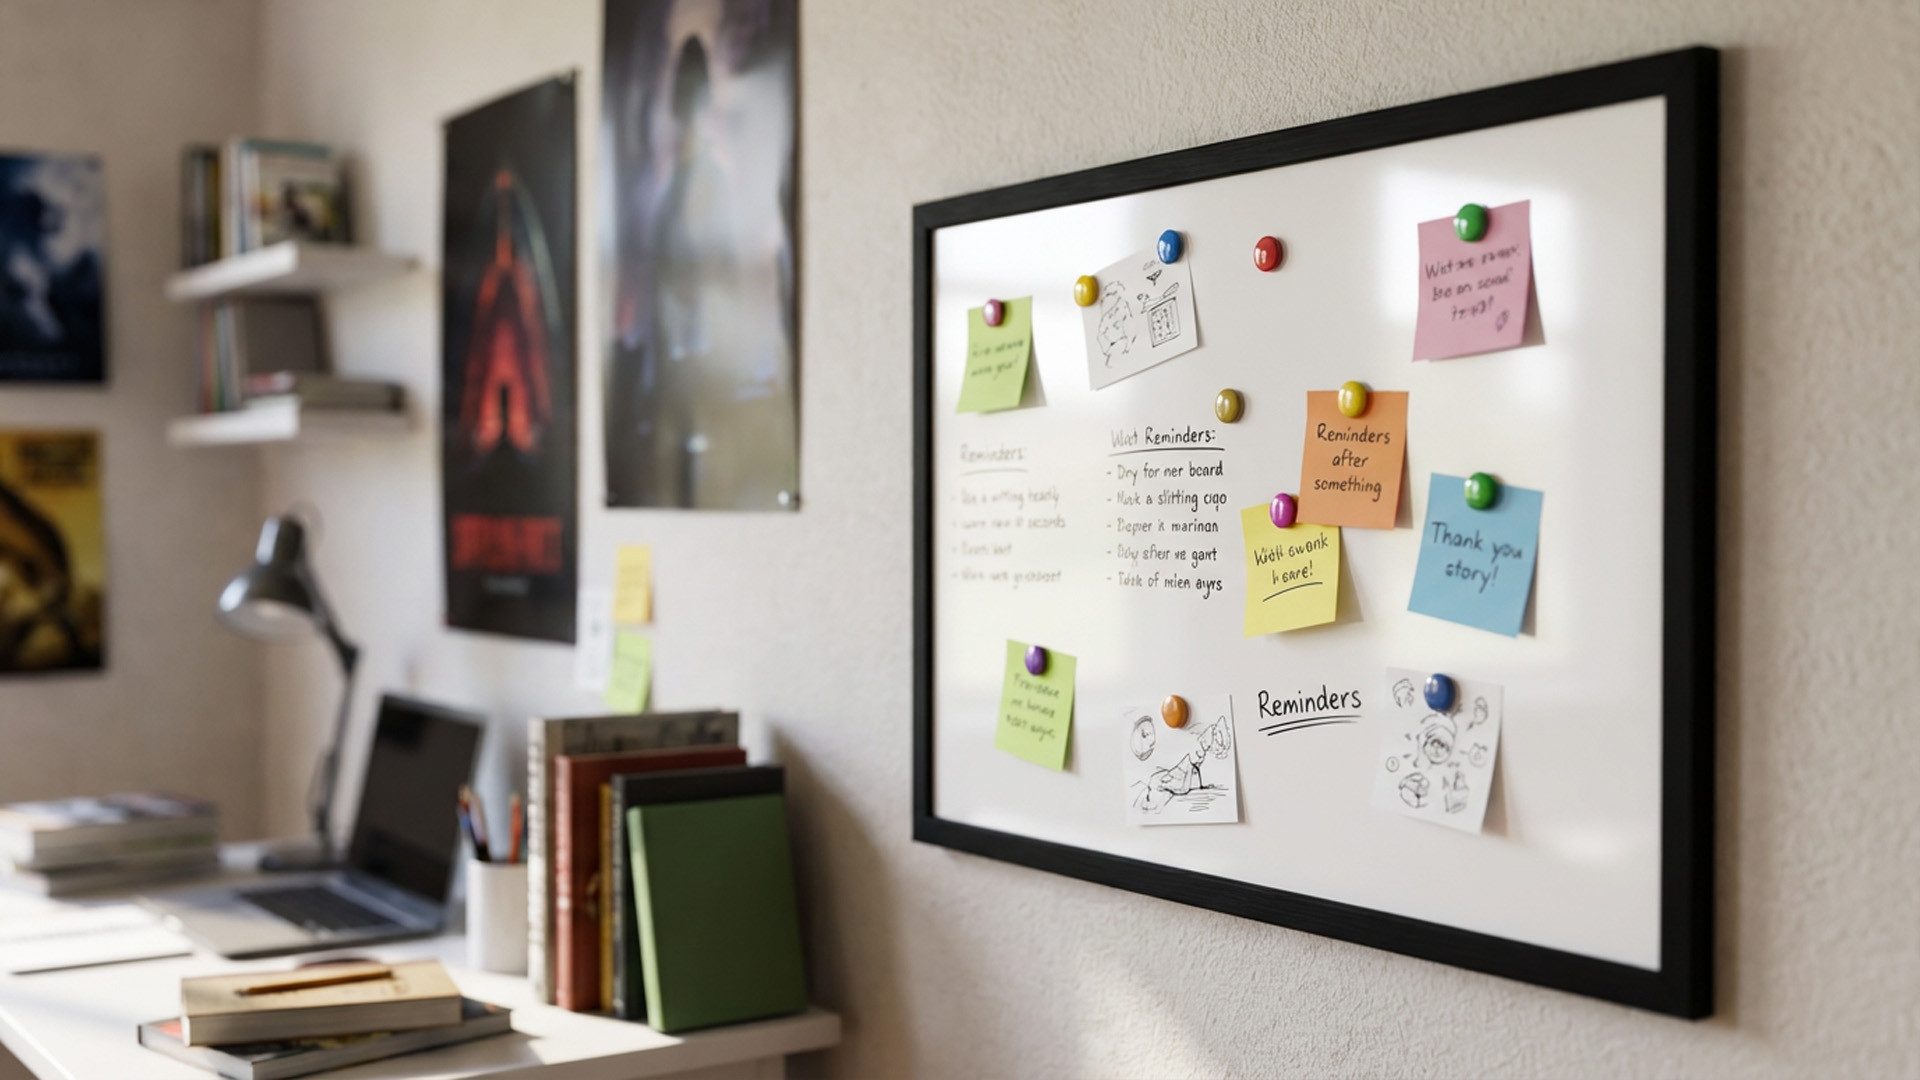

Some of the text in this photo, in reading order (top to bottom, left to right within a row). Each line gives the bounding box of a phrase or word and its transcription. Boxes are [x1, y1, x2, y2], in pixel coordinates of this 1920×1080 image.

[1145, 425, 1216, 445] Reminders:
[1316, 422, 1391, 444] Reminders
[1332, 448, 1369, 467] after
[1143, 462, 1160, 478] for
[1314, 475, 1382, 502] something
[1431, 520, 1523, 564] Thank you
[1445, 559, 1500, 594] story!
[1257, 684, 1363, 719] Reminders
